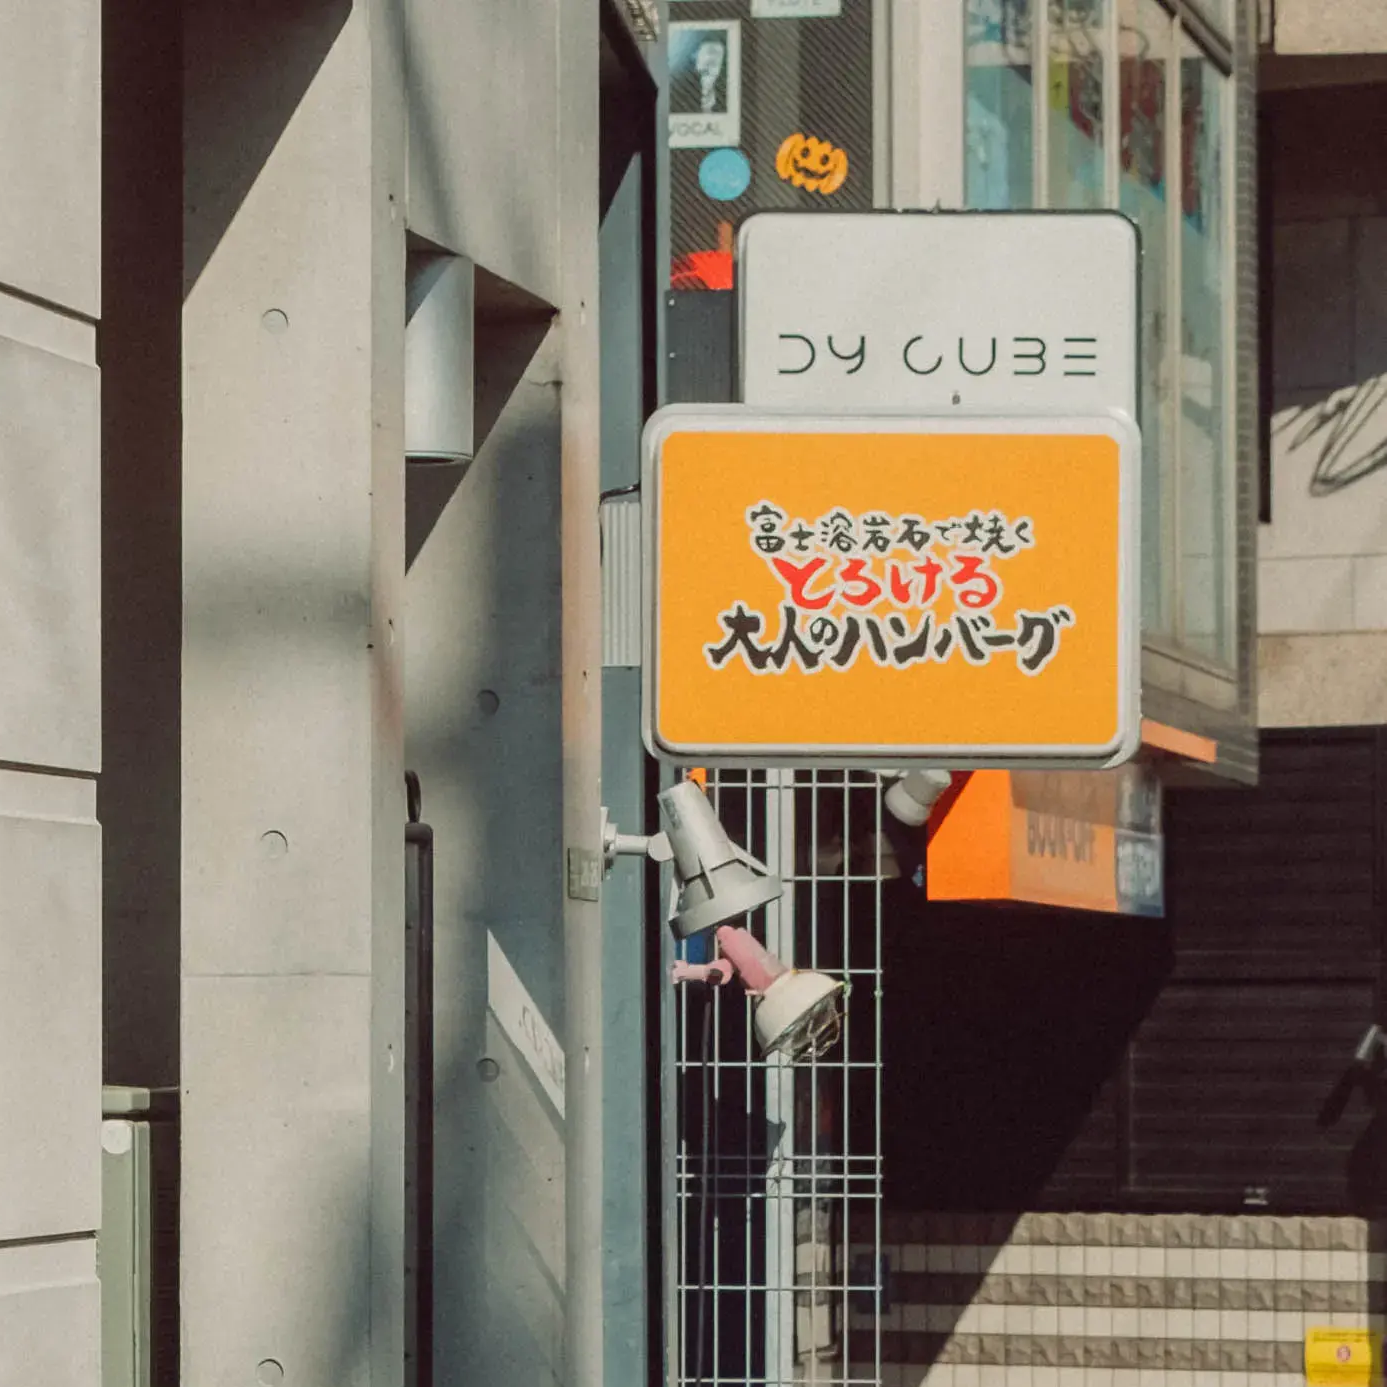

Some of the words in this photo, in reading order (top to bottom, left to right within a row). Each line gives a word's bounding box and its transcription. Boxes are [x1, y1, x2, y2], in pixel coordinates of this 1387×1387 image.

[903, 335, 1097, 376] CUBE
[750, 505, 1031, 554] 富士溶岩石で焼く
[771, 556, 998, 610] とろける
[708, 606, 1071, 672] 大人のハンバーグ
